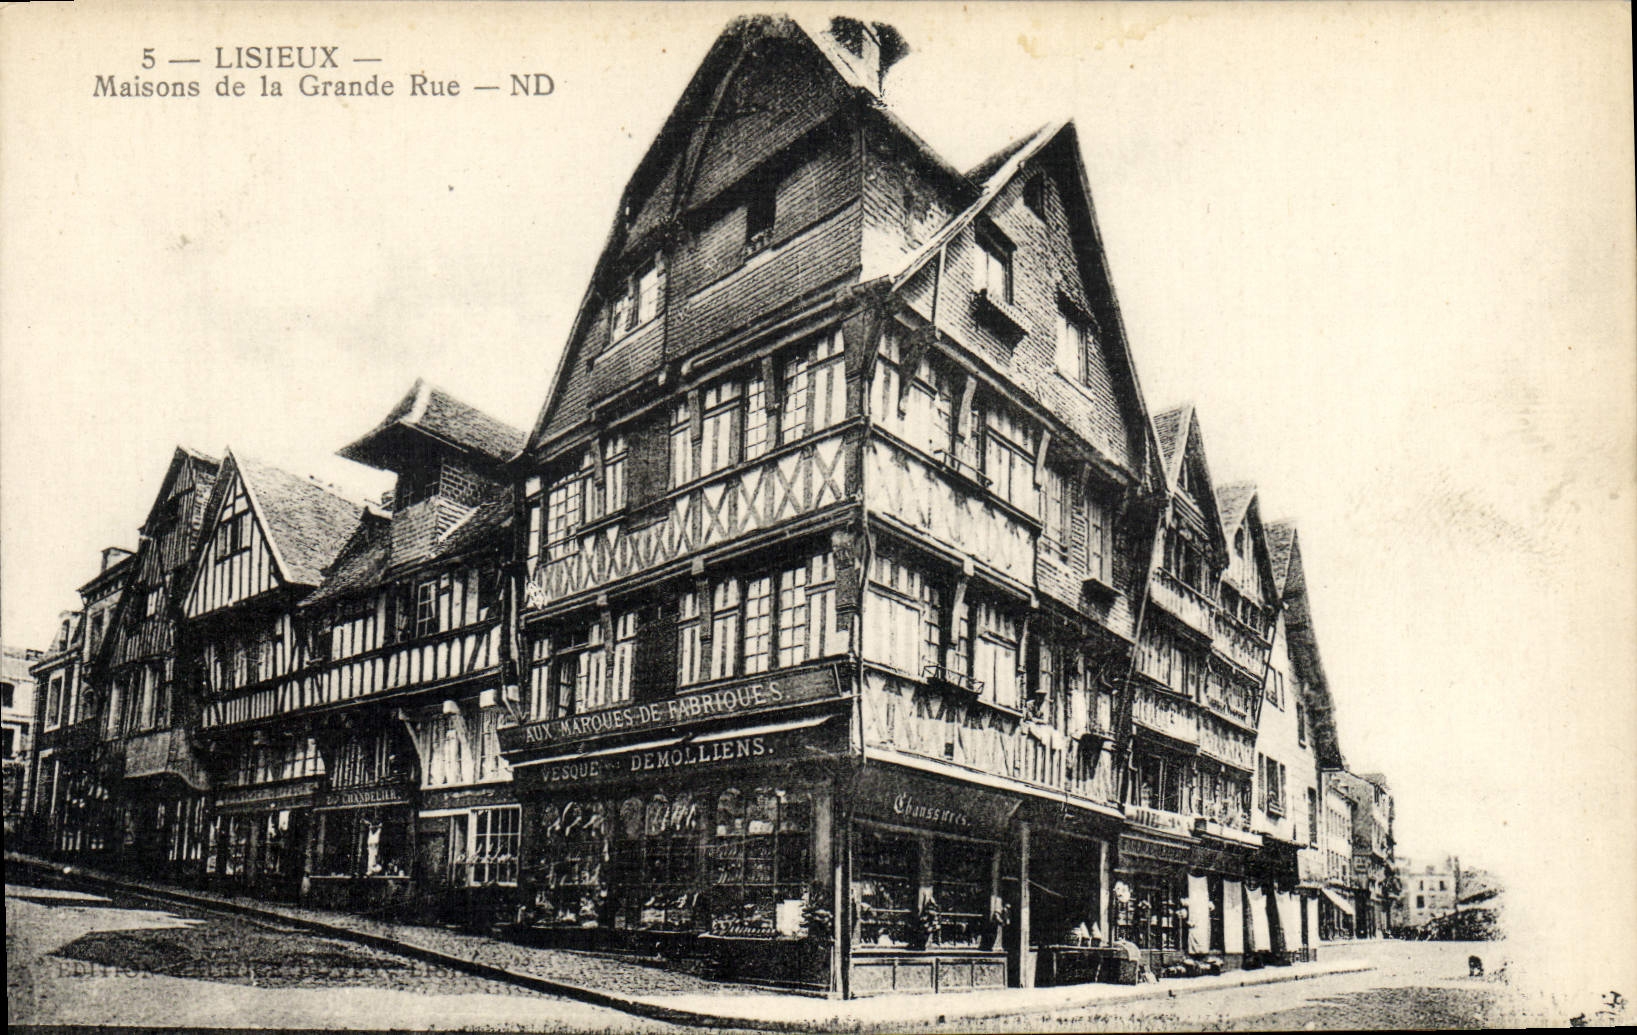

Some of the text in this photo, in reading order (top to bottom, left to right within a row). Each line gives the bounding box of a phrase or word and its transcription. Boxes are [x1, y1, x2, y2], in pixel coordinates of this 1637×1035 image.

[525, 723, 553, 743] AUX
[560, 709, 634, 737] MARQUES
[640, 704, 662, 724] DE
